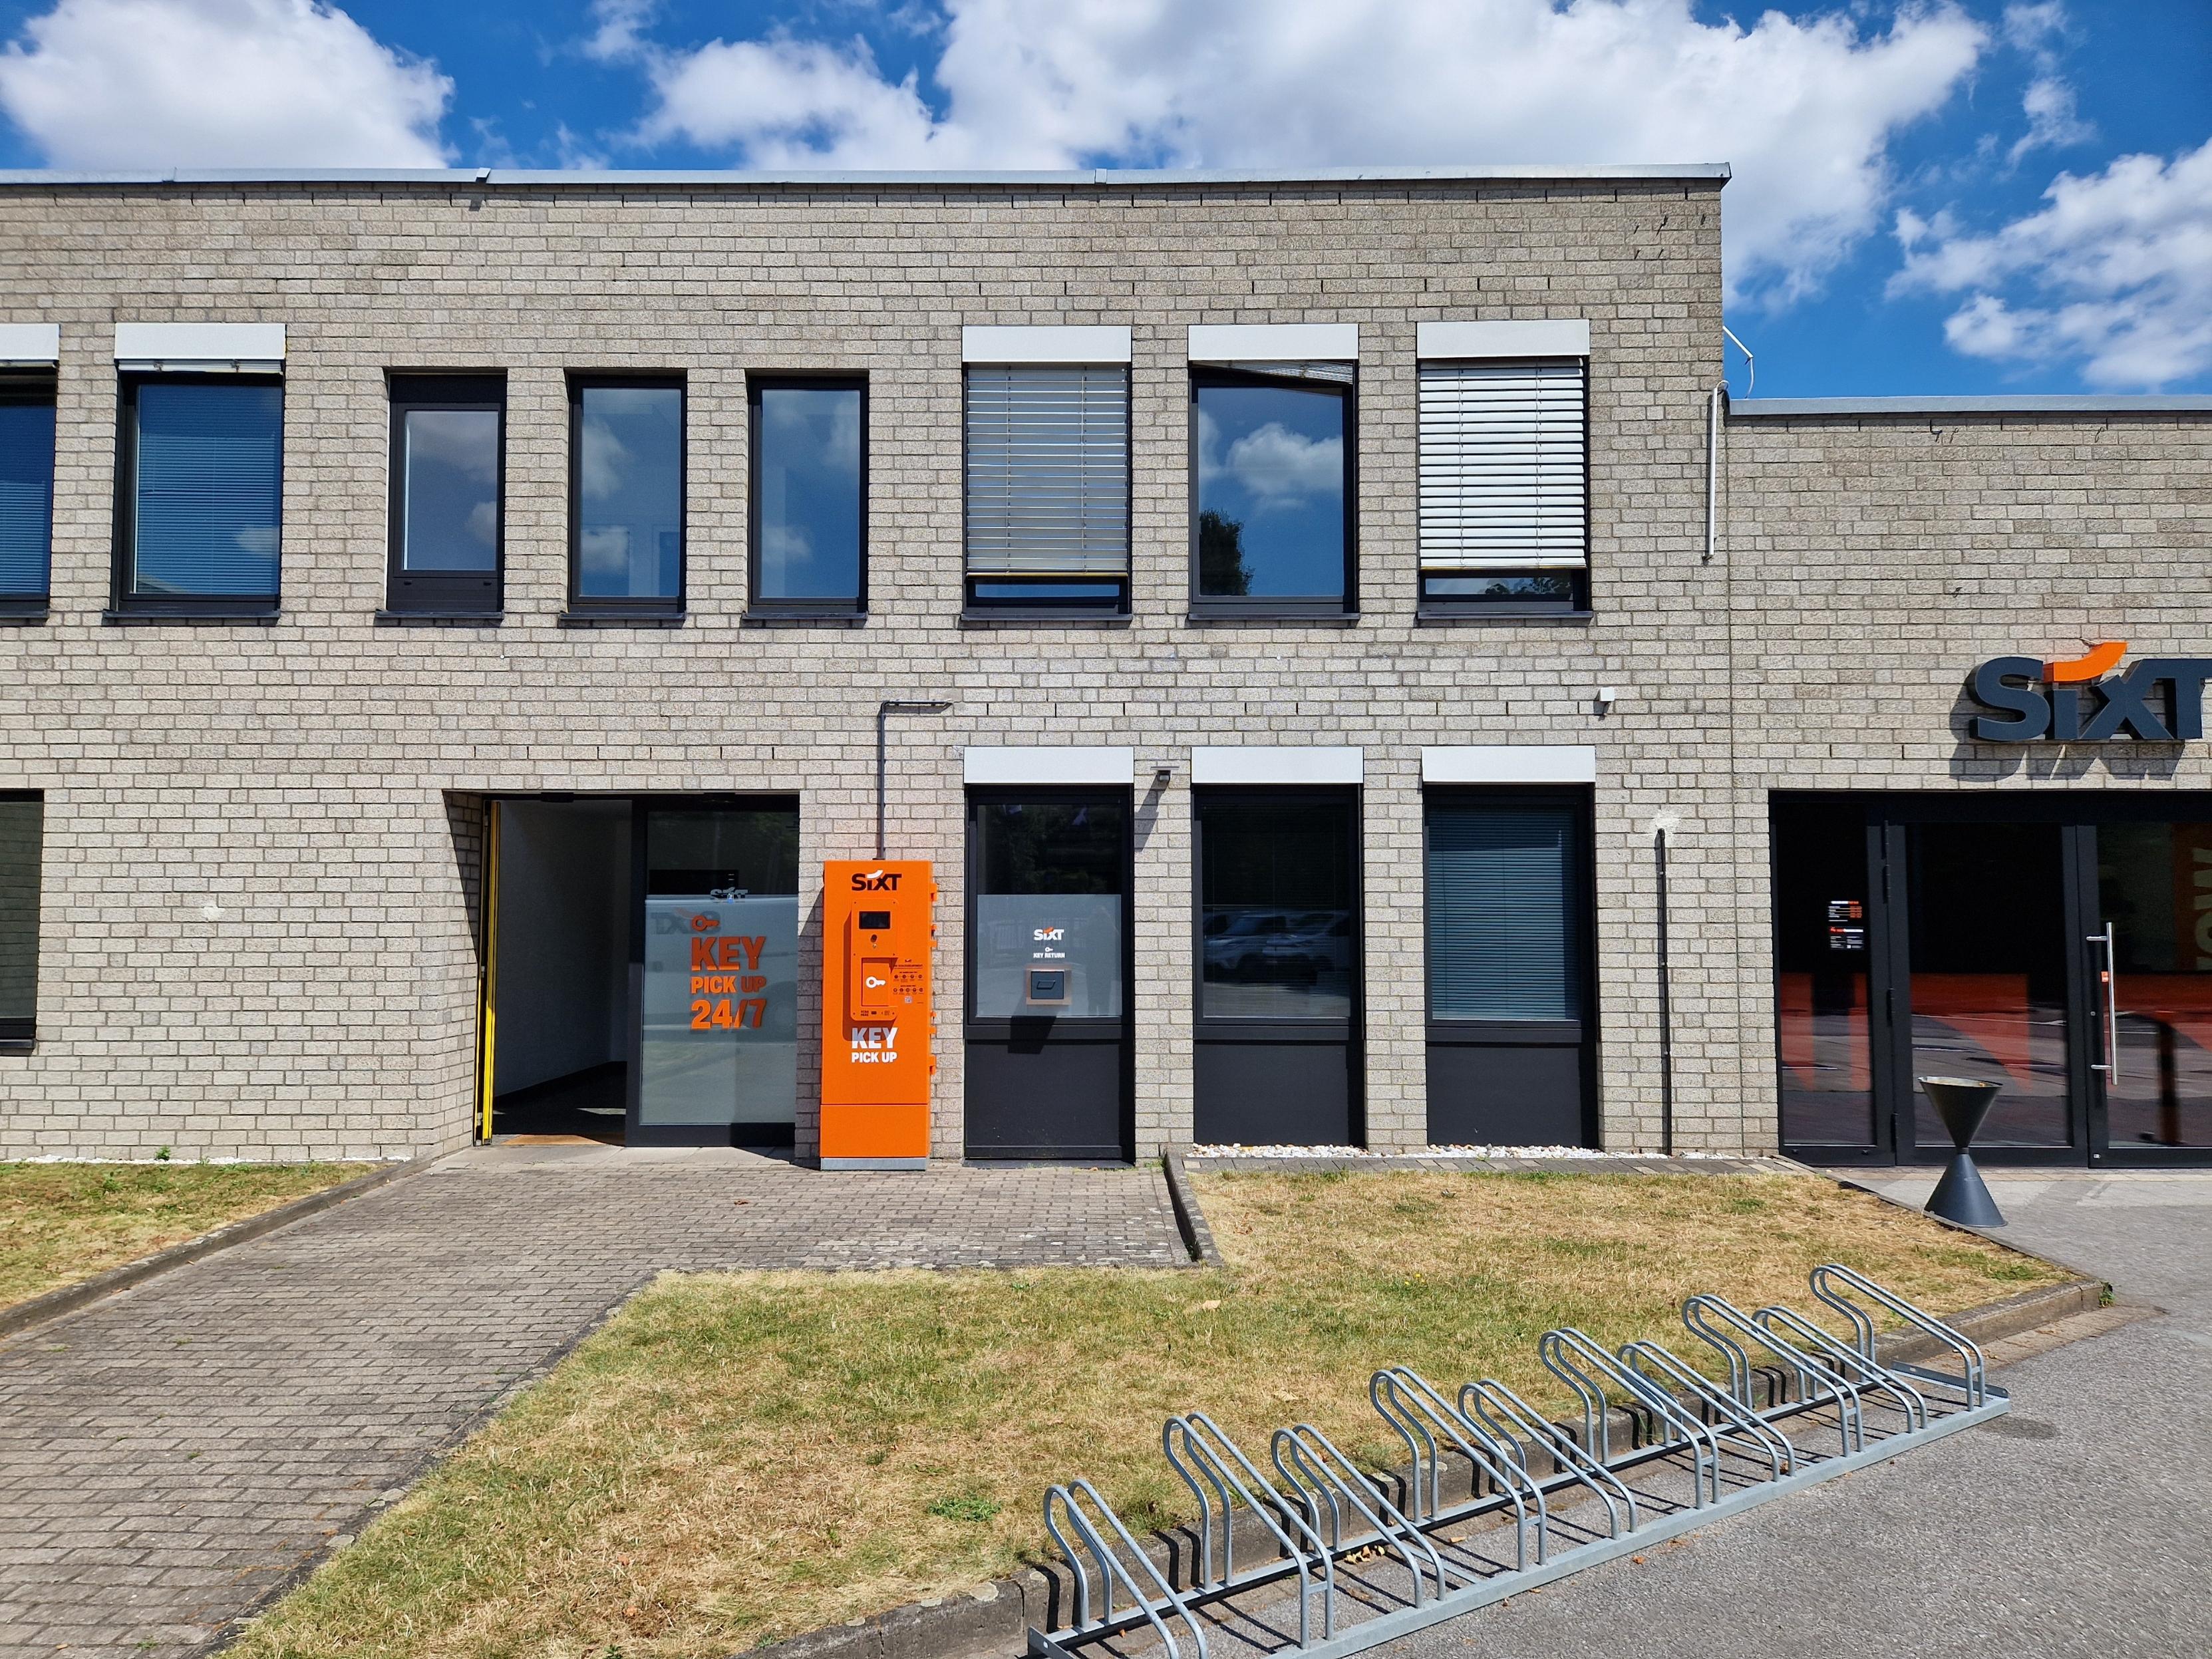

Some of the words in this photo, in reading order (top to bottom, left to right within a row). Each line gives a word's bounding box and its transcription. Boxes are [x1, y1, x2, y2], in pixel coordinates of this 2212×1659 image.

[1968, 641, 2212, 740] SIXT
[852, 869, 902, 891] SIXT
[1034, 926, 1064, 941] SIXT
[691, 937, 766, 971] KEY
[691, 975, 737, 994] PICK
[740, 976, 767, 993] UP
[691, 998, 767, 1029] 24/7
[852, 1027, 898, 1049] KEY
[851, 1052, 879, 1063] PICK
[881, 1052, 897, 1063] UP
